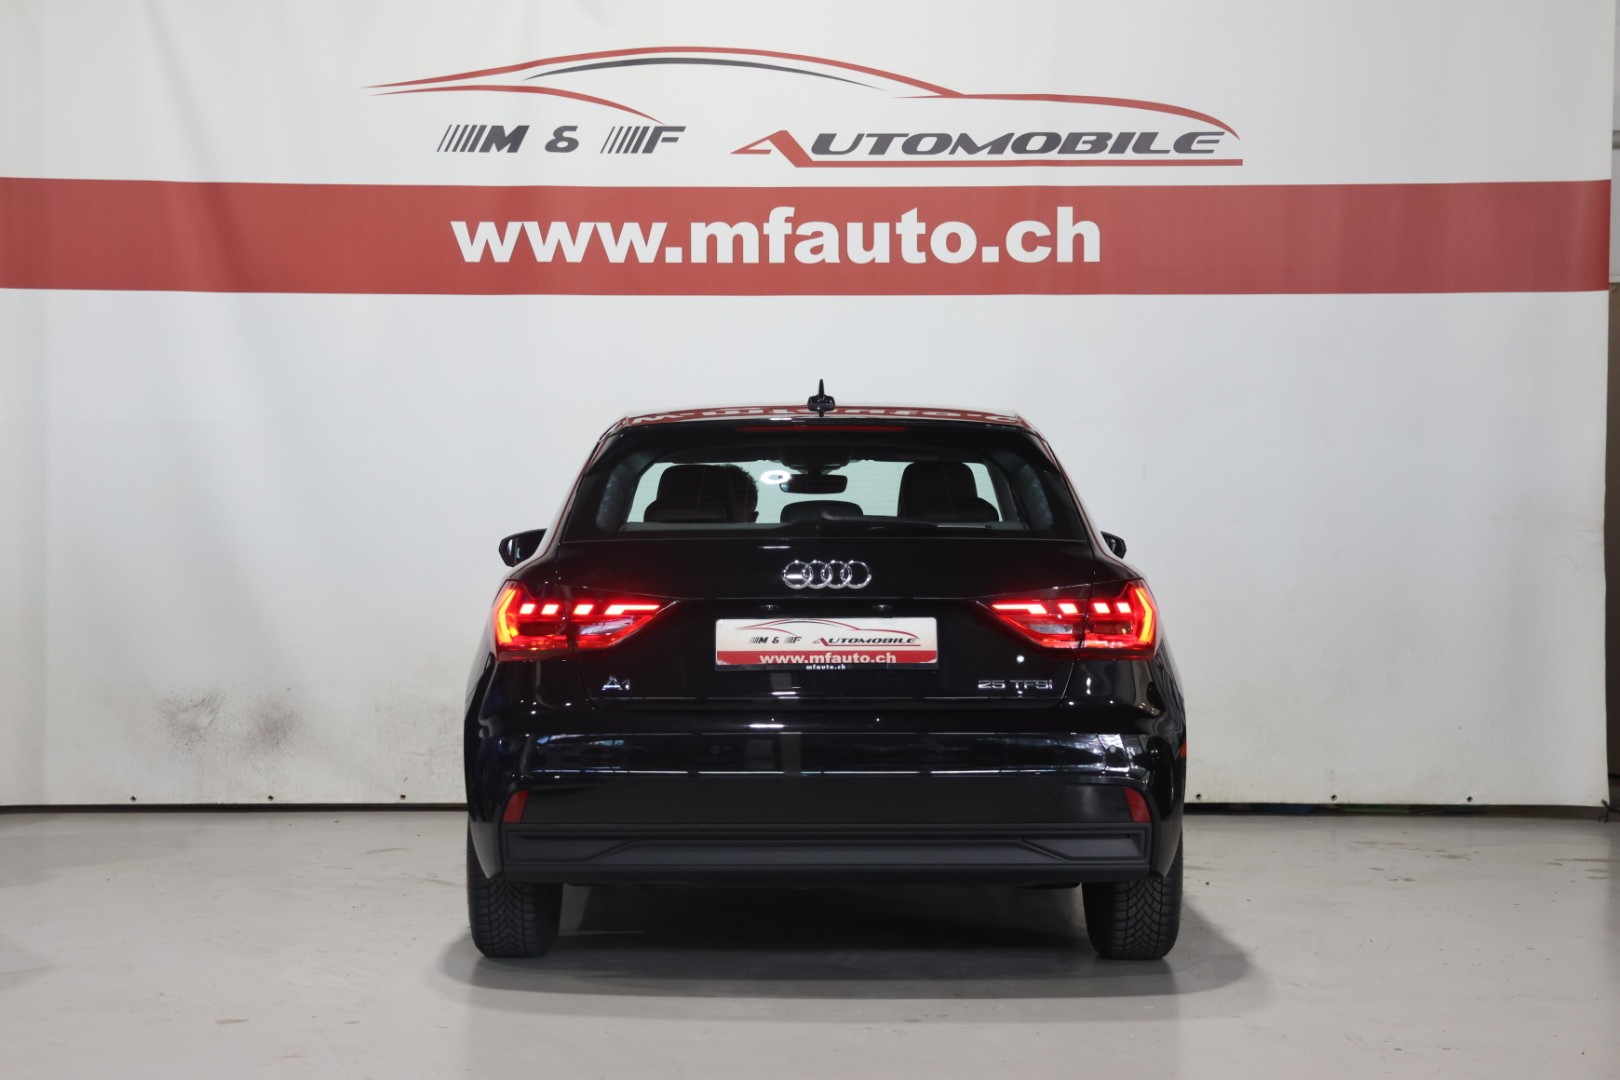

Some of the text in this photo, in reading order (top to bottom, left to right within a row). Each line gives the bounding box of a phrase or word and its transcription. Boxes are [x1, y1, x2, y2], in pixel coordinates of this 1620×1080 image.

[544, 125, 579, 153] &
[730, 130, 1226, 168] AUTOMOBILE
[450, 206, 1101, 264] www.mfauto.ch
[759, 652, 897, 664] www.mfauto.ch
[978, 680, 1006, 689] 25
